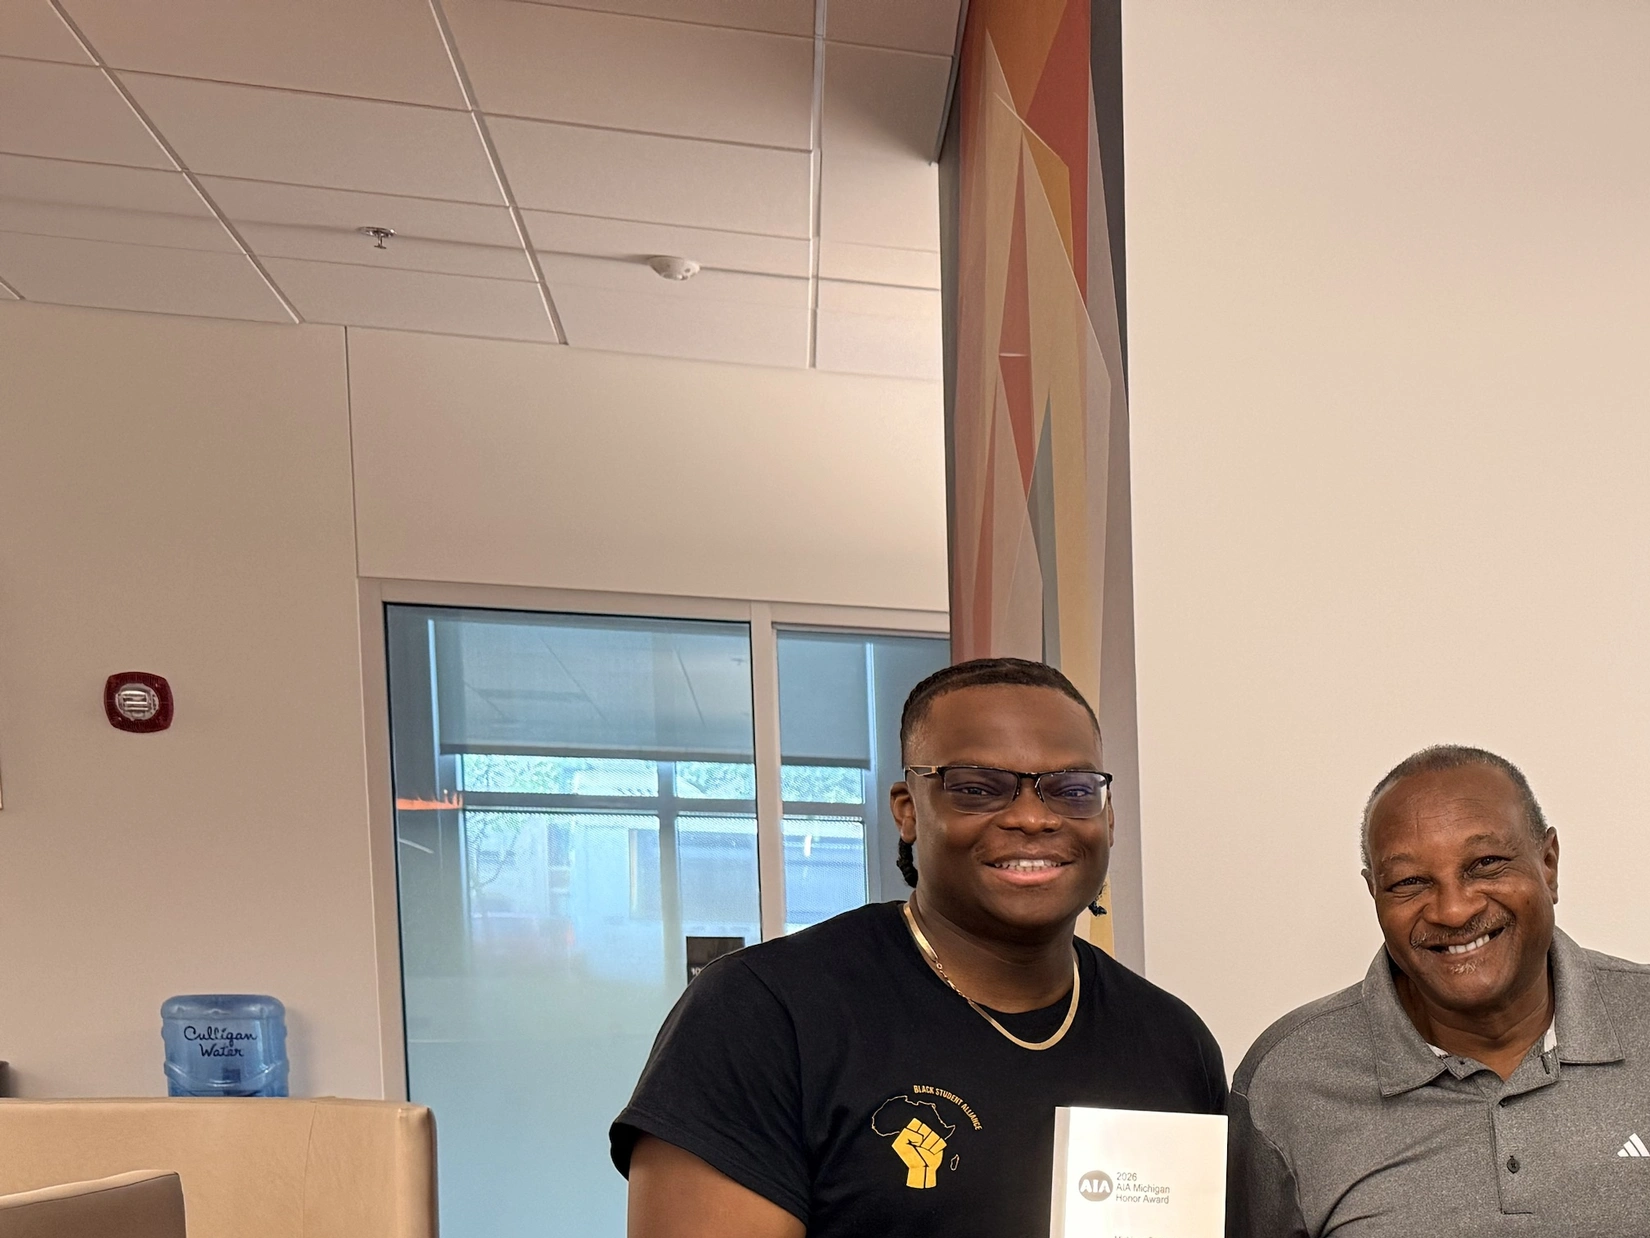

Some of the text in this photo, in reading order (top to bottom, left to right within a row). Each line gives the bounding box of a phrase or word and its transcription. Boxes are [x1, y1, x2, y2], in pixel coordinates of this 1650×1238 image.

[183, 1025, 258, 1048] Culligan
[198, 1043, 245, 1058] Water
[913, 1084, 983, 1131] BLACK STUDENT ALLIANCE
[1116, 1171, 1138, 1182] 2026
[1079, 1179, 1111, 1193] AIA
[1116, 1182, 1170, 1195] AIA Michigan
[1115, 1194, 1169, 1204] Honor Award
